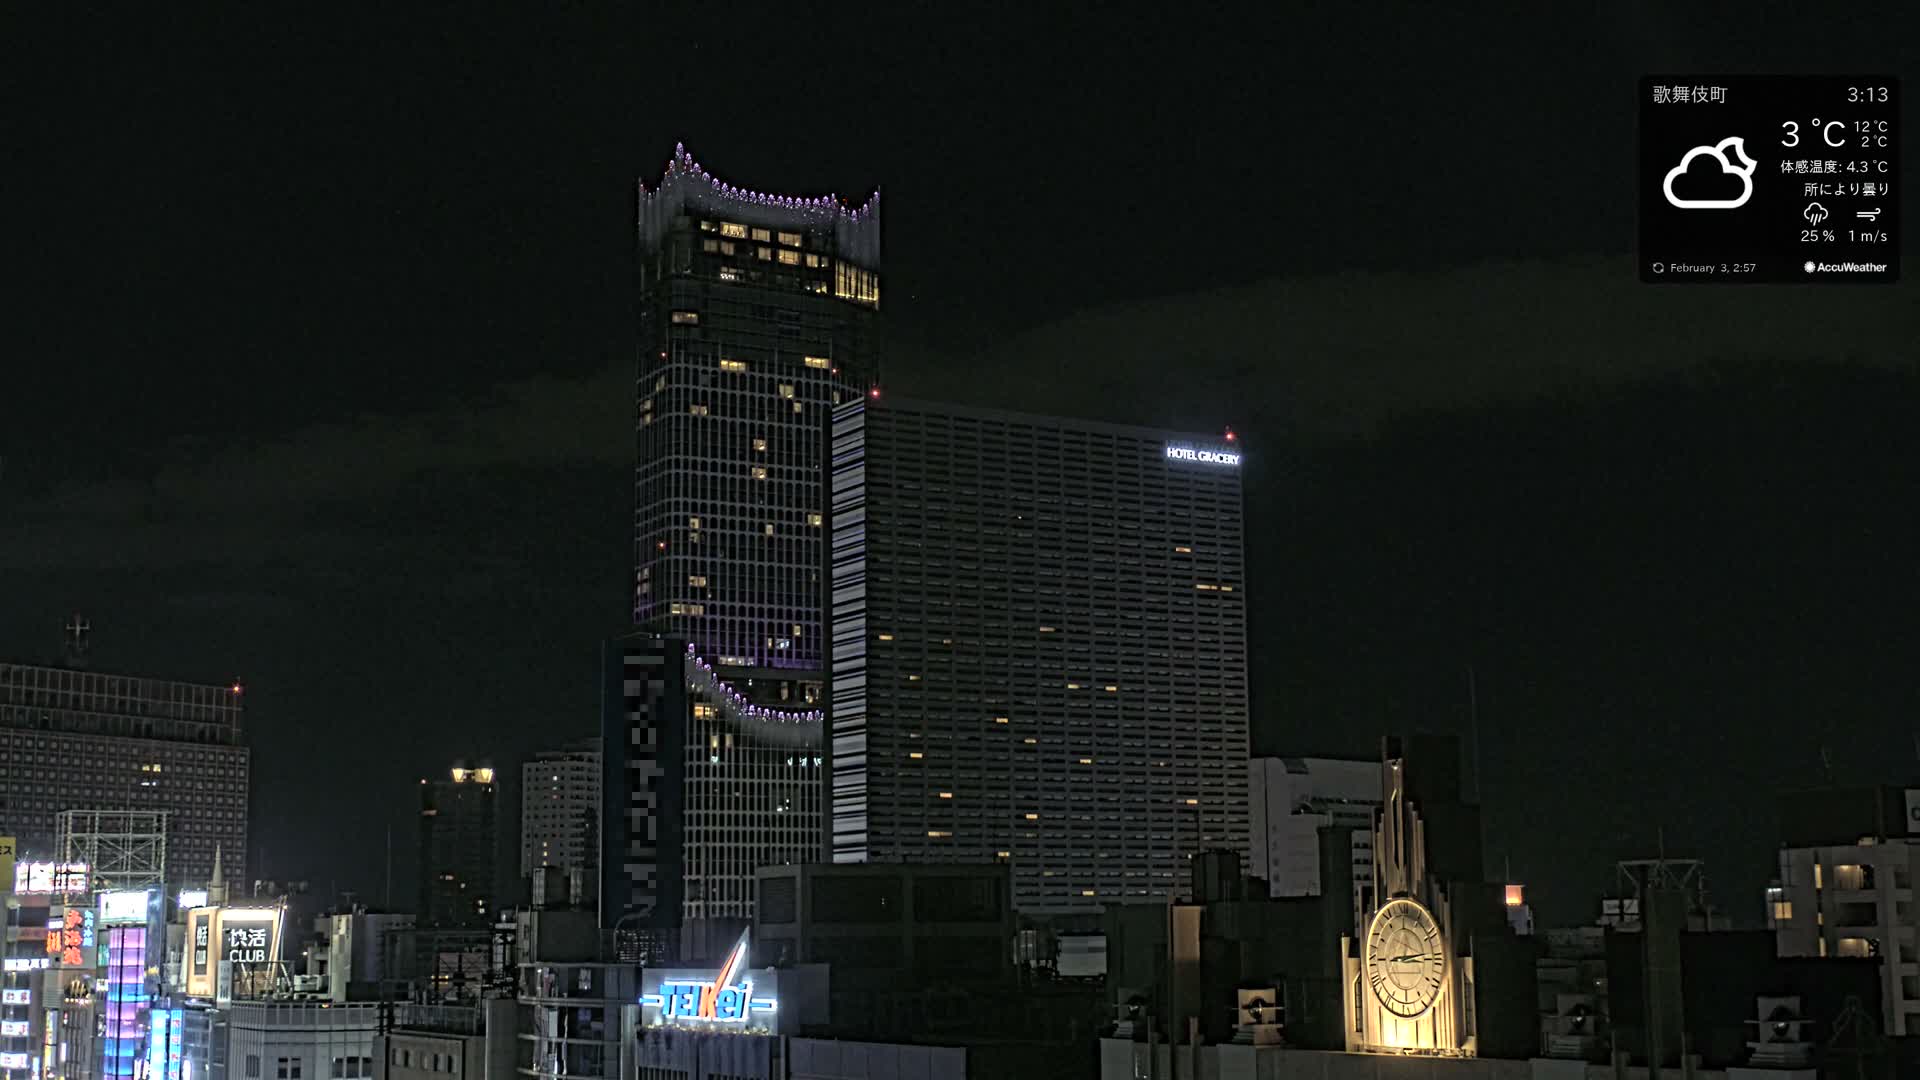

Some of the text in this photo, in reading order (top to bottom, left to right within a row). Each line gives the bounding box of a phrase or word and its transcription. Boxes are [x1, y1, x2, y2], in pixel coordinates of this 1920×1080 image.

[1166, 447, 1240, 465] HOTEL GRACERY
[229, 928, 267, 948] 快活
[229, 949, 266, 963] CLUB
